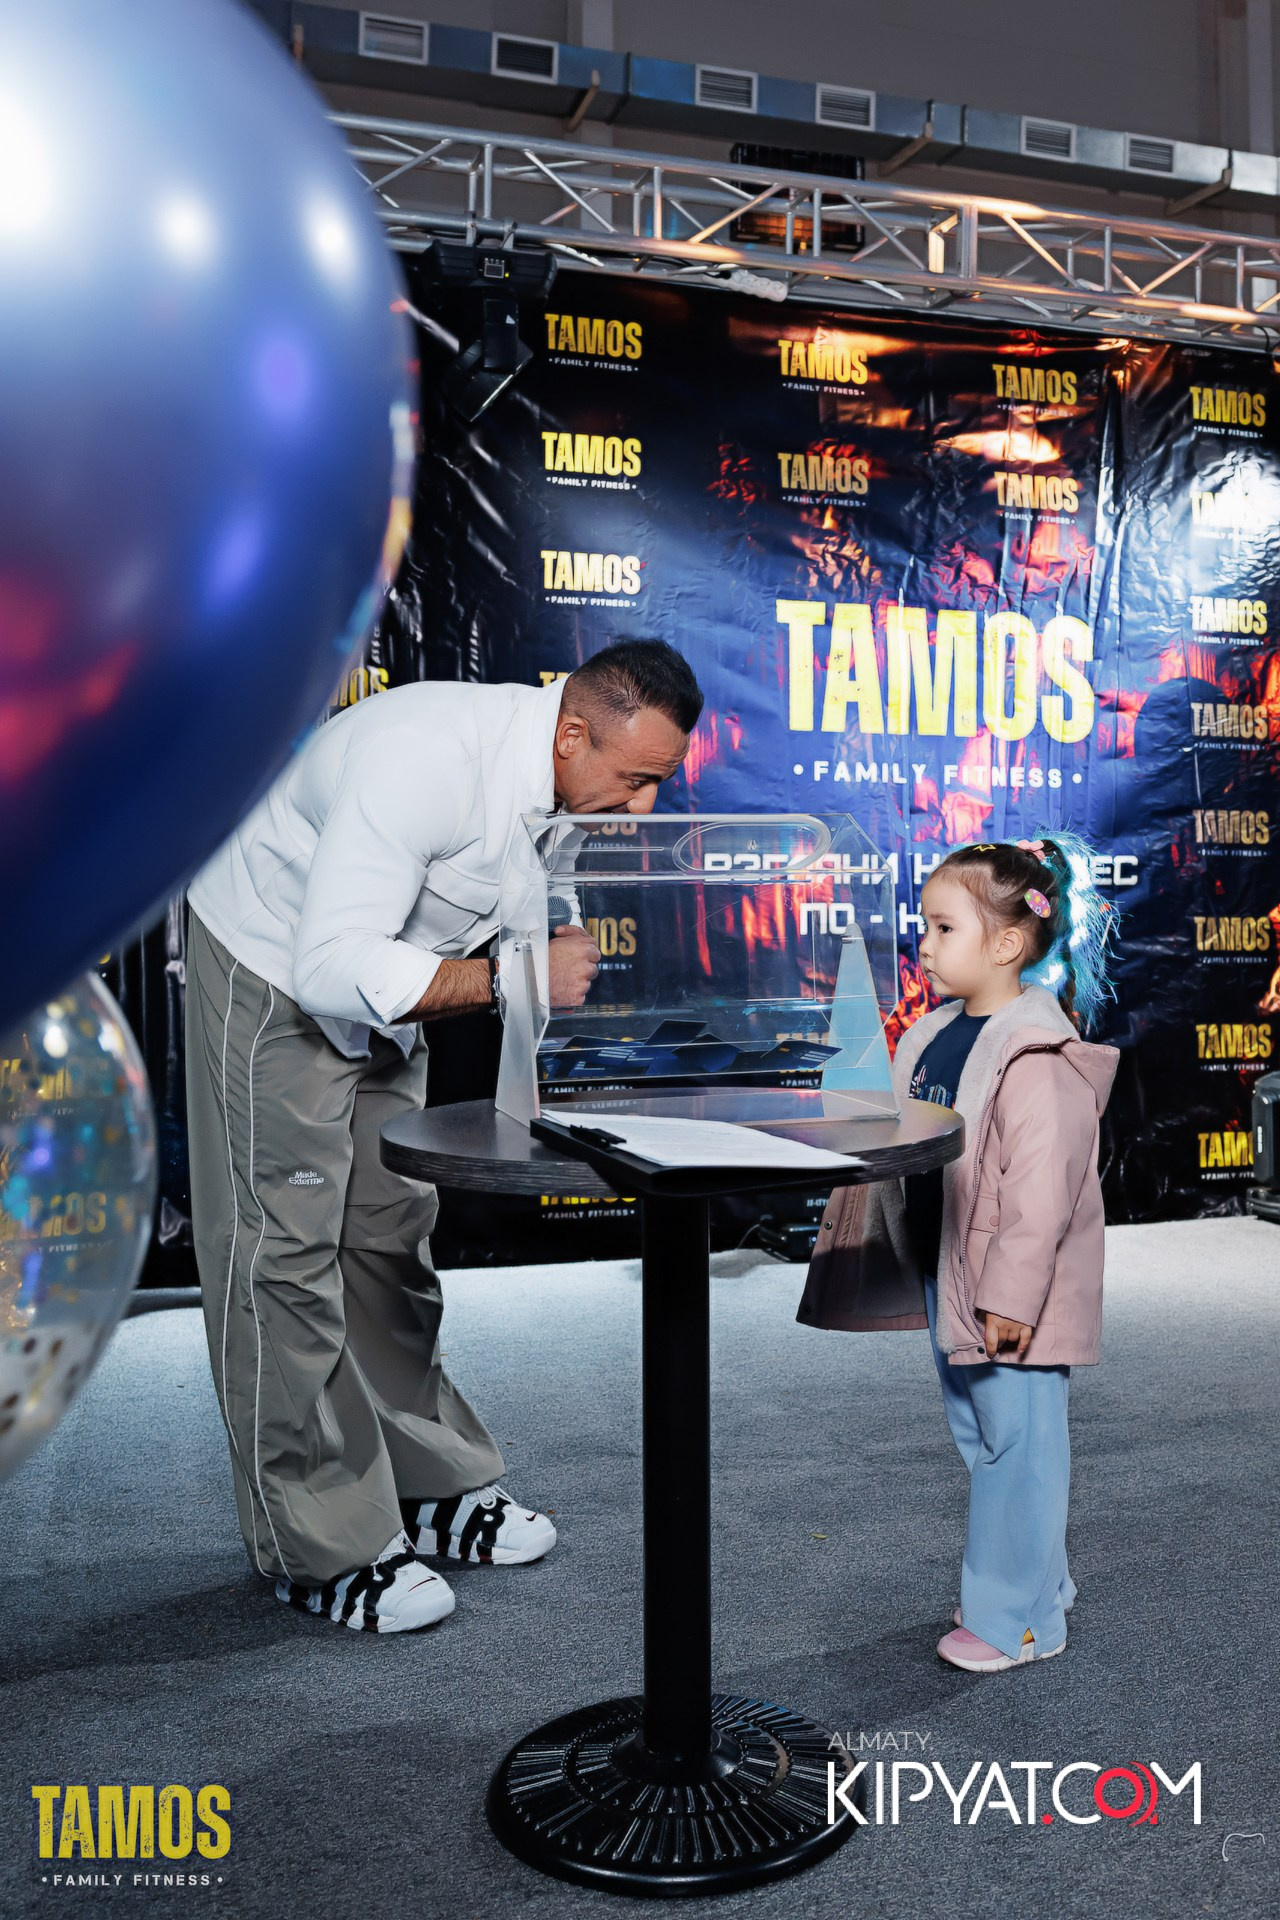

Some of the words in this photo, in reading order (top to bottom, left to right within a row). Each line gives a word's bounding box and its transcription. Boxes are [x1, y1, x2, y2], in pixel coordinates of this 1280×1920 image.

[544, 313, 643, 360] TAMOS
[554, 358, 590, 368] FAMILY
[594, 361, 633, 372] FITNESS
[778, 340, 868, 385] TAMOS
[787, 383, 821, 392] FAMILY
[823, 386, 861, 396] FITNESS
[992, 364, 1077, 405] TAMOS
[1189, 387, 1266, 427] TAMOS
[1198, 426, 1226, 435] FAMILY
[1228, 429, 1259, 438] FITNESS
[541, 432, 642, 477] TAMOS
[551, 477, 587, 487] FAMILY
[591, 480, 630, 490] FITNESS
[778, 453, 869, 495] TAMOS
[994, 472, 1079, 512] TAMOS
[787, 495, 821, 505] FAMILY
[823, 498, 861, 507] FITNESS
[541, 550, 641, 595] TAMOS
[550, 596, 587, 605] FAMILY
[590, 598, 630, 607] FITNESS
[1189, 596, 1267, 635] TAMOS
[776, 599, 1095, 743] TAMOS
[1191, 702, 1269, 739] TAMOS
[813, 760, 927, 785] FAMILY
[943, 765, 1063, 789] FITNESS
[1192, 809, 1270, 845] TAMOS
[800, 902, 855, 935] ПО
[1194, 916, 1271, 951] TAMOS
[1196, 1024, 1272, 1059] TAMOS
[1198, 1131, 1254, 1168] TAM
